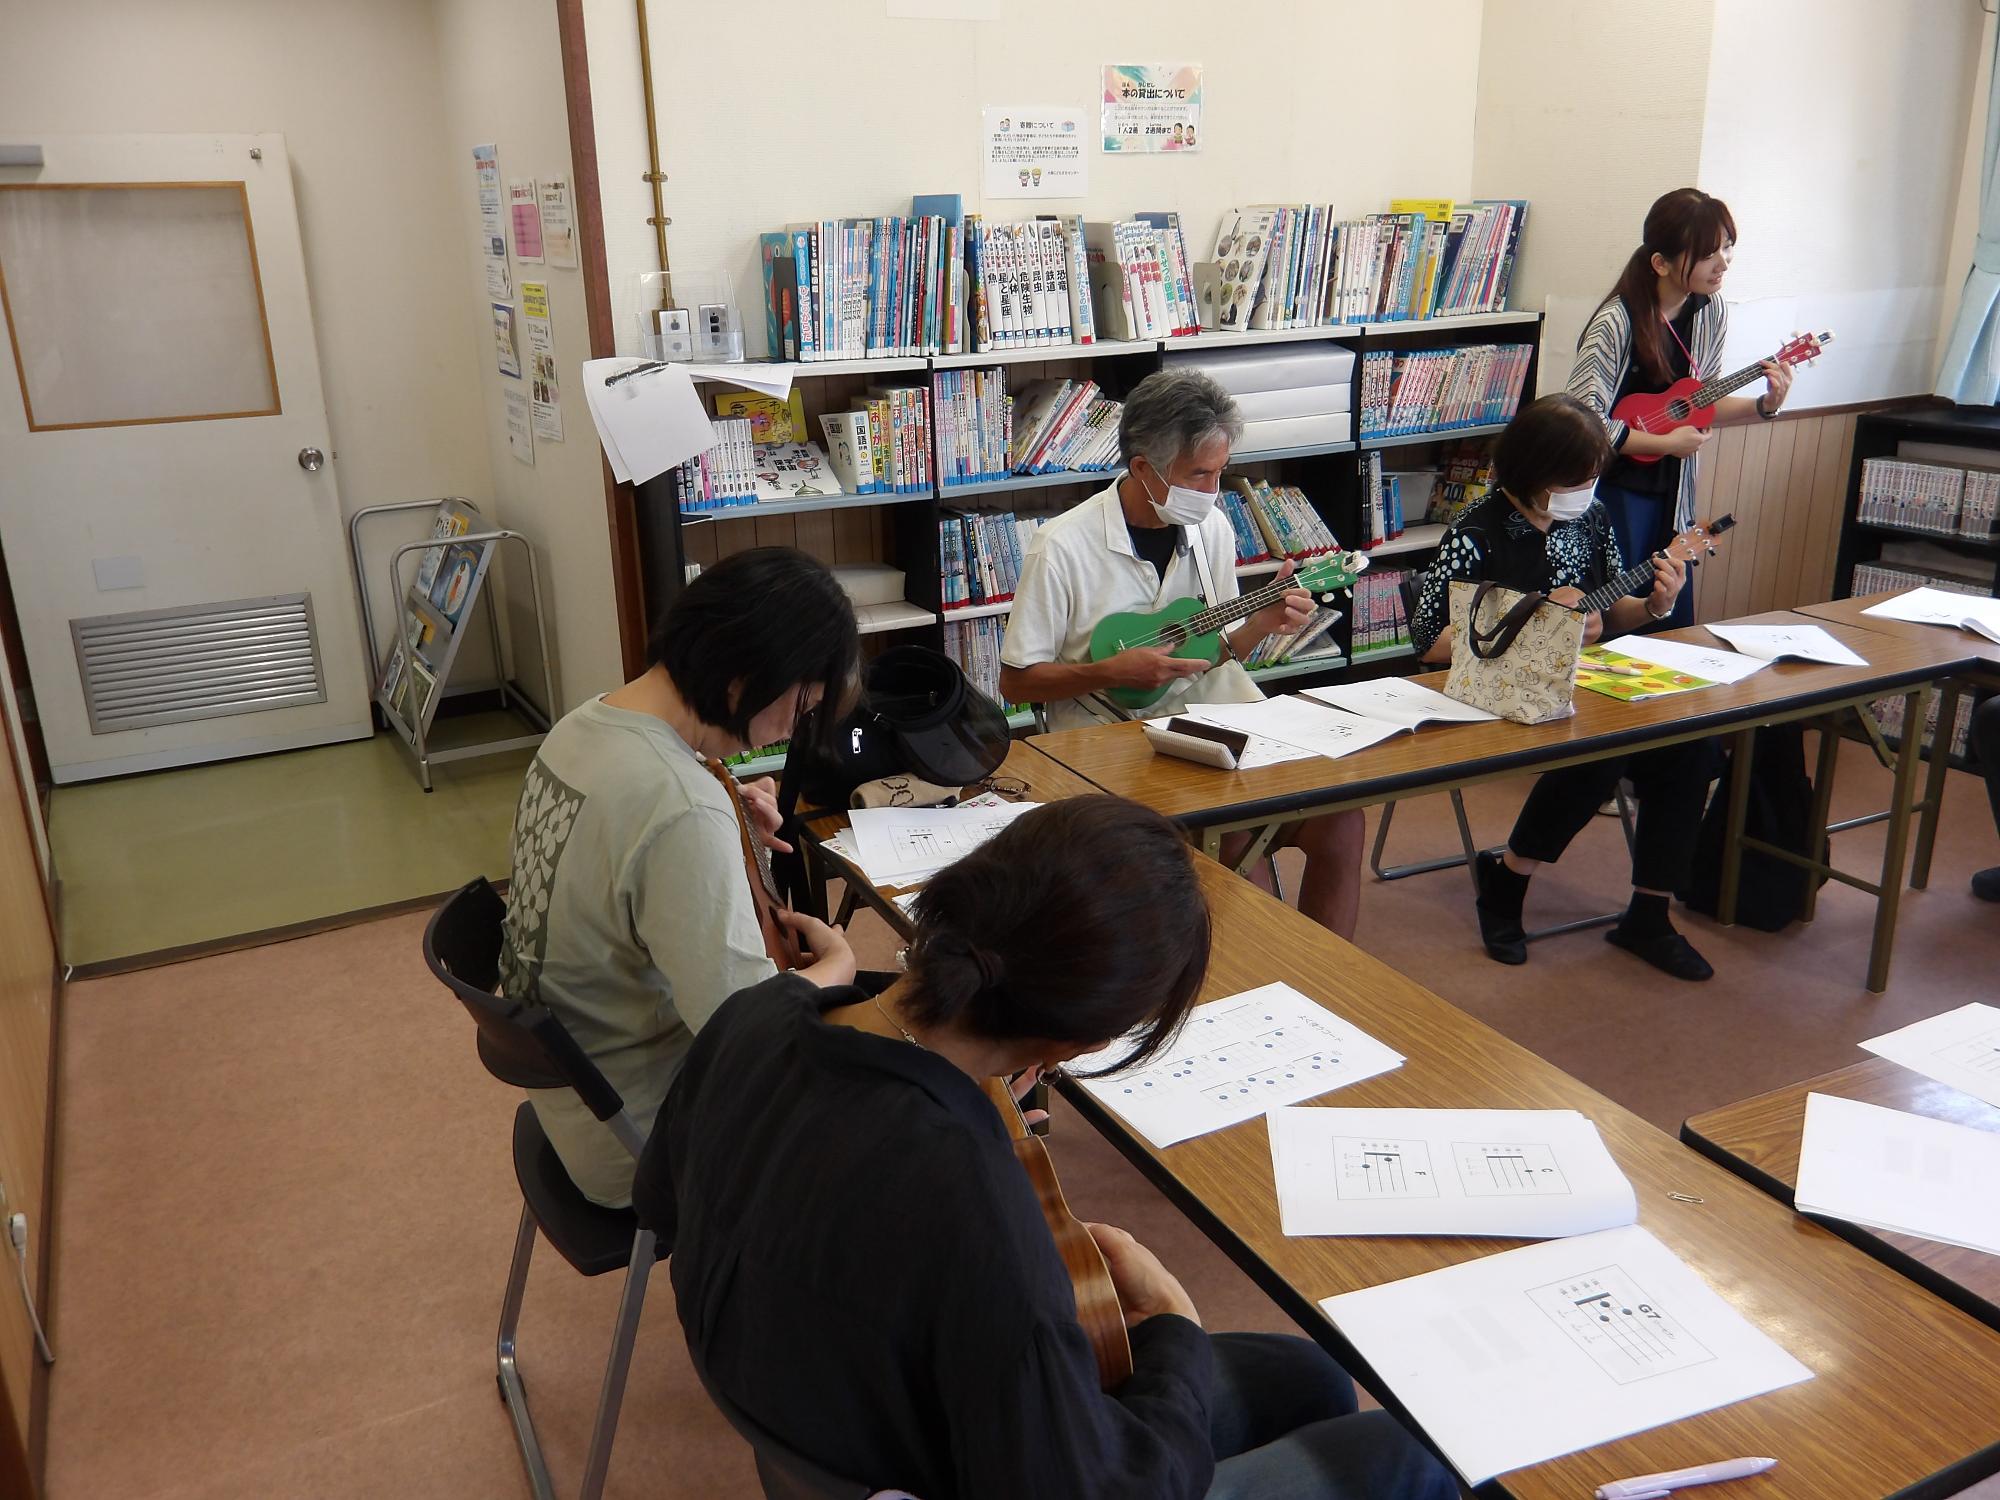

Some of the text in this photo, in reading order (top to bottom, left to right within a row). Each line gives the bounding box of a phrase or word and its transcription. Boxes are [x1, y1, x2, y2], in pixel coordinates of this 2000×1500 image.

[1121, 88, 1185, 99] 本の貸出について
[1020, 121, 1054, 129] 寄贈について
[988, 274, 996, 285] 魚
[1009, 272, 1018, 294] 人体
[1032, 270, 1042, 292] 昆虫
[1045, 270, 1056, 292] 鉄道
[1056, 270, 1066, 291] 恐竜
[999, 273, 1011, 316] 星と星座
[1019, 272, 1032, 315] 危険生物
[798, 286, 812, 342] ひとのからだ
[856, 426, 866, 445] 国語
[1638, 1302, 1661, 1320] G7
